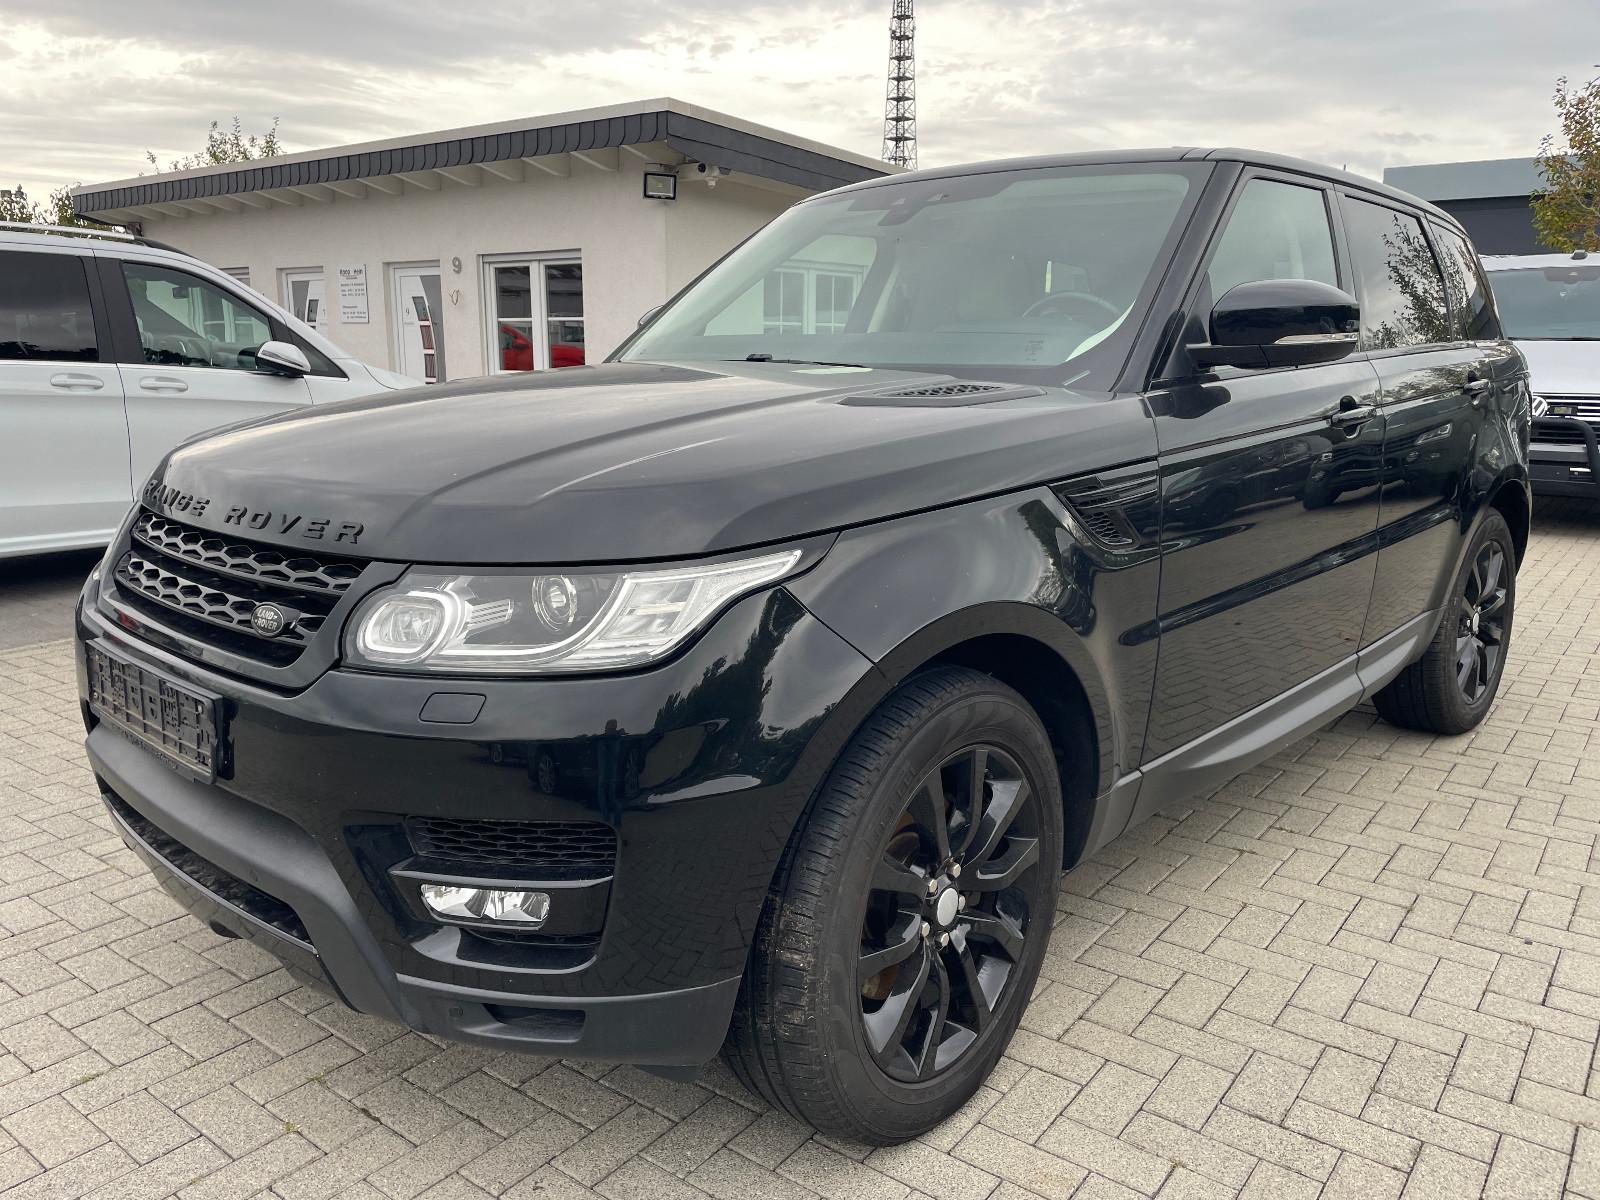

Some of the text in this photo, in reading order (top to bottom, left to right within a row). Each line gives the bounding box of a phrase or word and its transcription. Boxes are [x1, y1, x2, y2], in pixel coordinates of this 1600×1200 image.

[452, 256, 462, 275] 9
[143, 479, 365, 544] RANGE ROVER
[257, 608, 275, 620] LAND
[256, 618, 278, 630] ROVER
